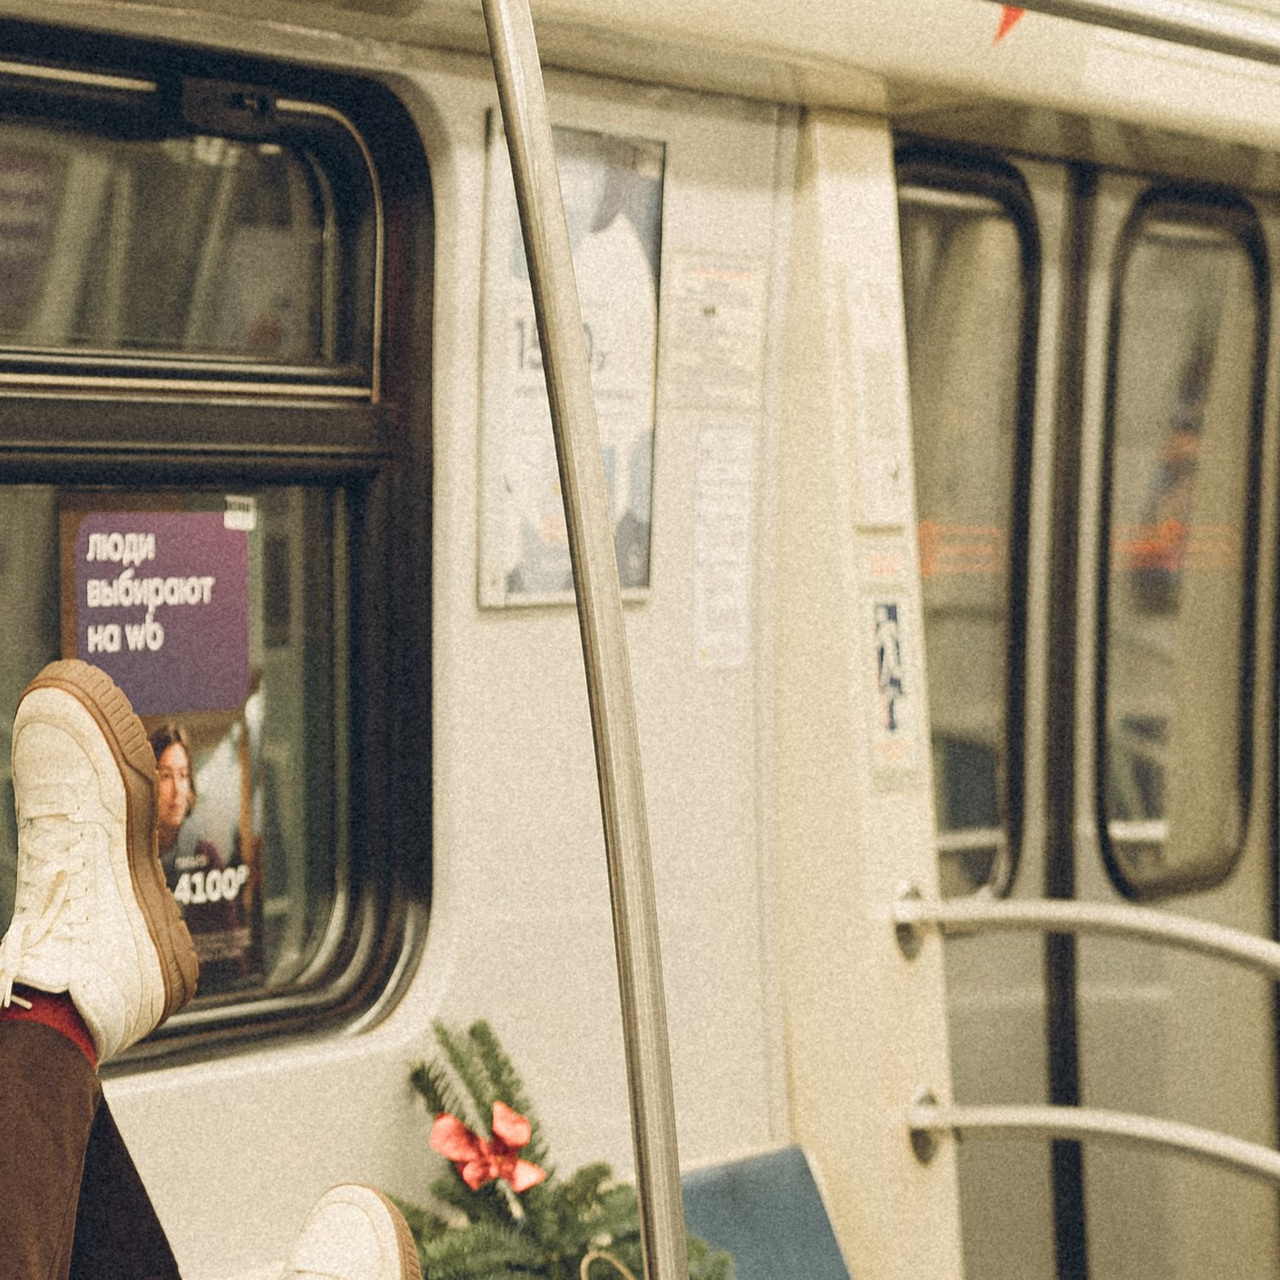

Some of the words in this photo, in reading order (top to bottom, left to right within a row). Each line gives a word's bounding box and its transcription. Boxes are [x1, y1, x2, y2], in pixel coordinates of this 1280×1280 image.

[86, 532, 155, 567] люди
[86, 567, 216, 614] выбирают
[87, 623, 122, 653] на
